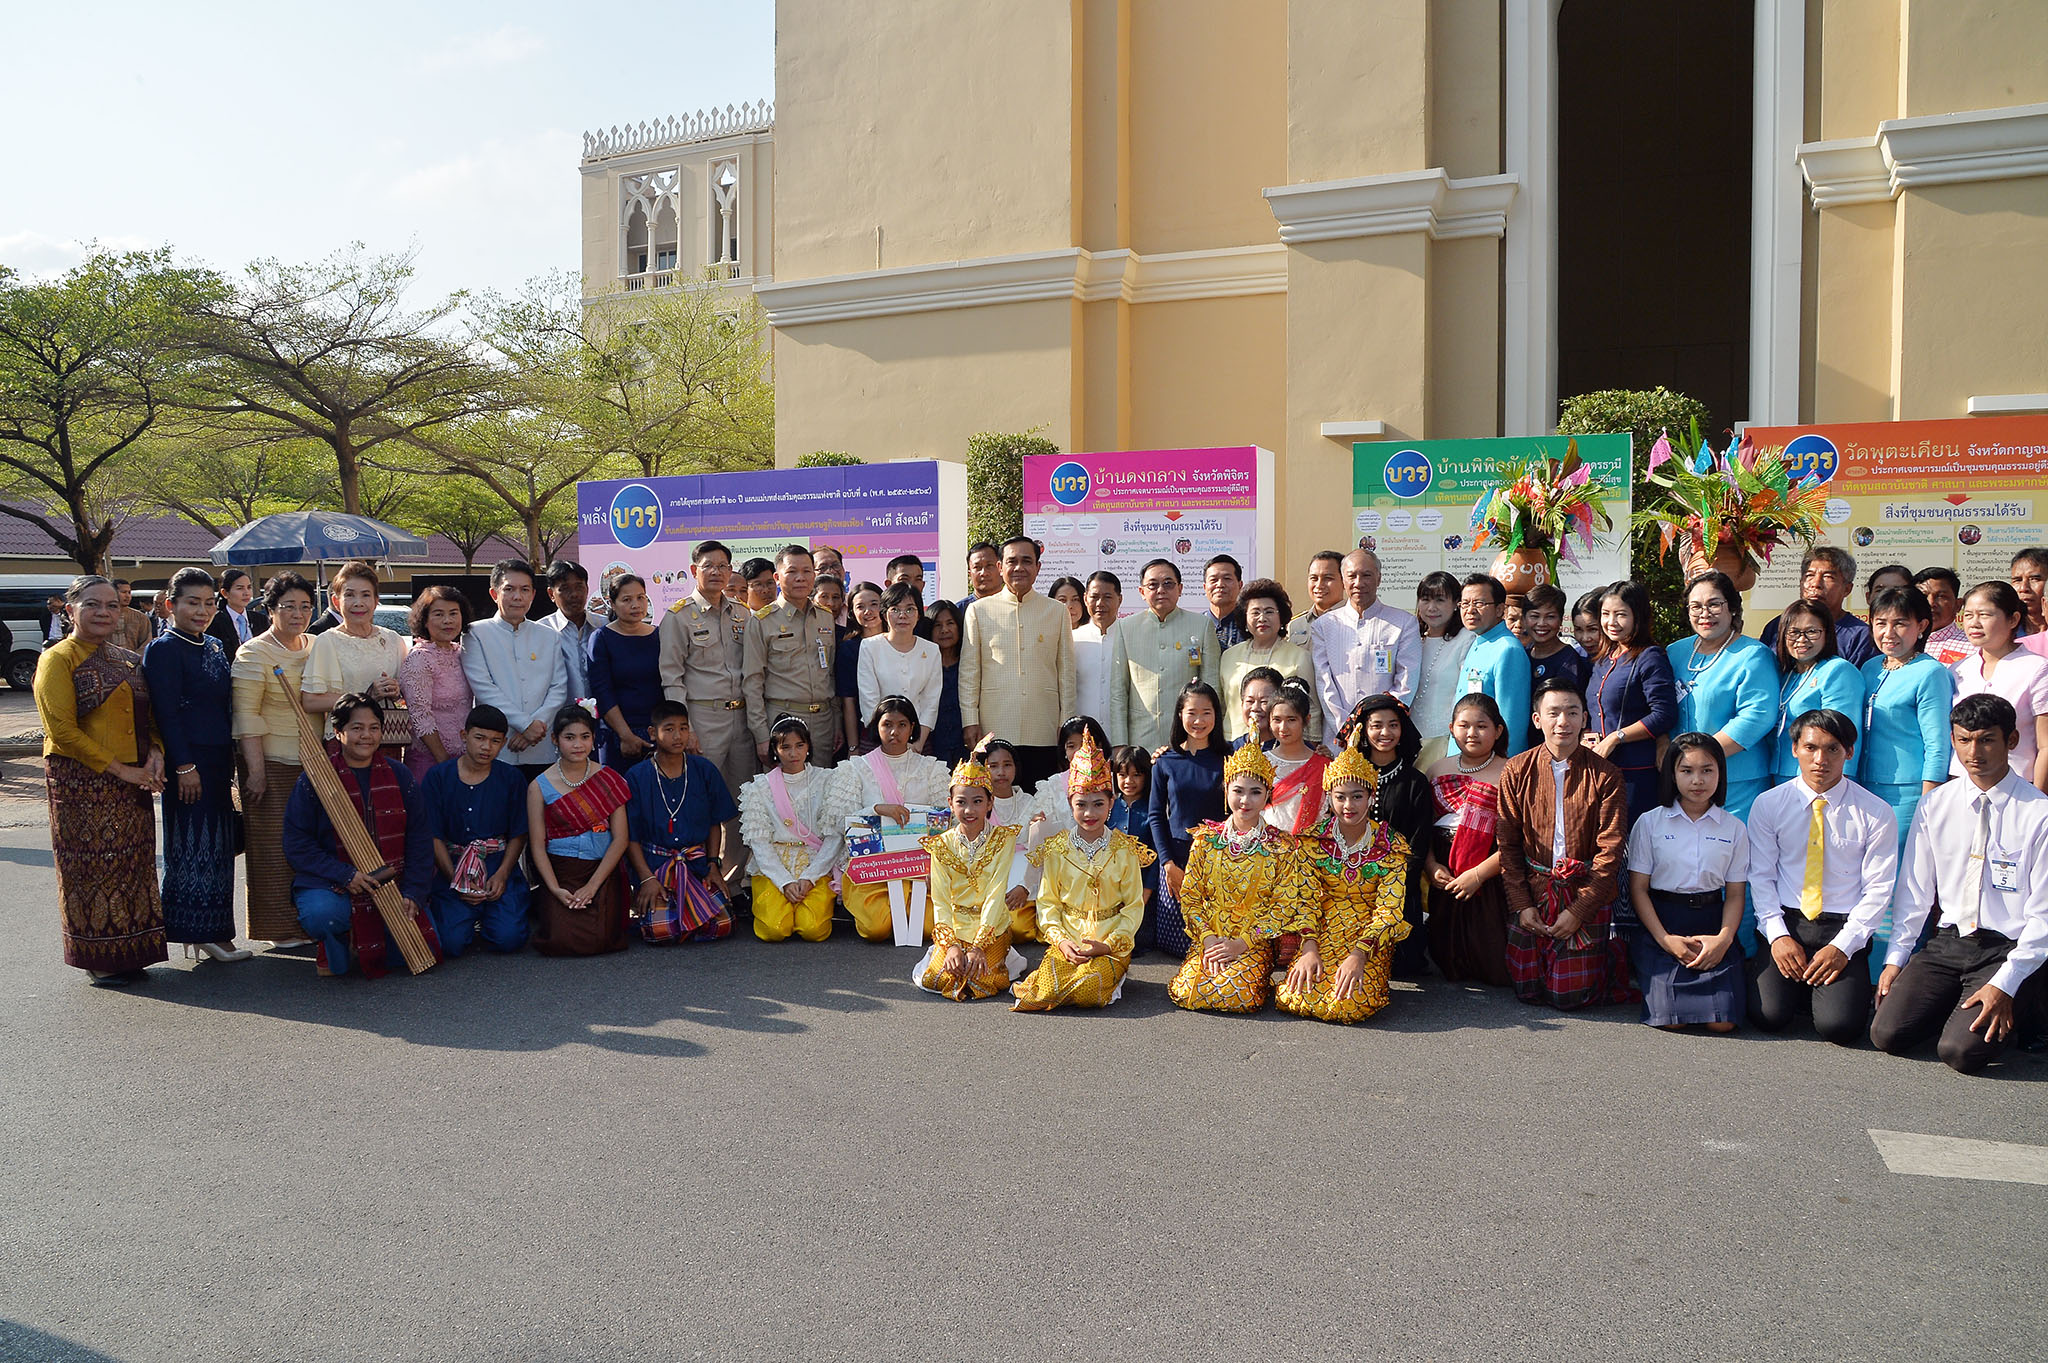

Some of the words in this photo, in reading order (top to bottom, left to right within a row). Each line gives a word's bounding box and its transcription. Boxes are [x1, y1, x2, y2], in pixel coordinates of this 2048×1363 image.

[1844, 440, 1960, 464] วัดพุตะเคียน
[1094, 467, 1187, 485] บ้านดงกลาง
[1192, 468, 1249, 481] จังหวัดพิจิตร
[1387, 465, 1428, 483] บวร
[1053, 475, 1087, 492] บวร
[1842, 478, 1928, 495] เทิดทูนสถาบันชาติ
[1931, 479, 1965, 489] ศาสนา
[1156, 499, 1179, 507] ศาสนา
[582, 507, 607, 525] พลัง
[613, 505, 657, 528] บวร
[866, 512, 892, 527] “คนดี
[895, 511, 934, 526] สังคมดี”
[1885, 502, 2026, 522] สิ่งที่ชุมชนคุณธรรมได้รับ
[1123, 519, 1222, 534] สิ่งที่ชุมชนคุณธรรมได้รับ
[2000, 876, 2008, 885] 5
